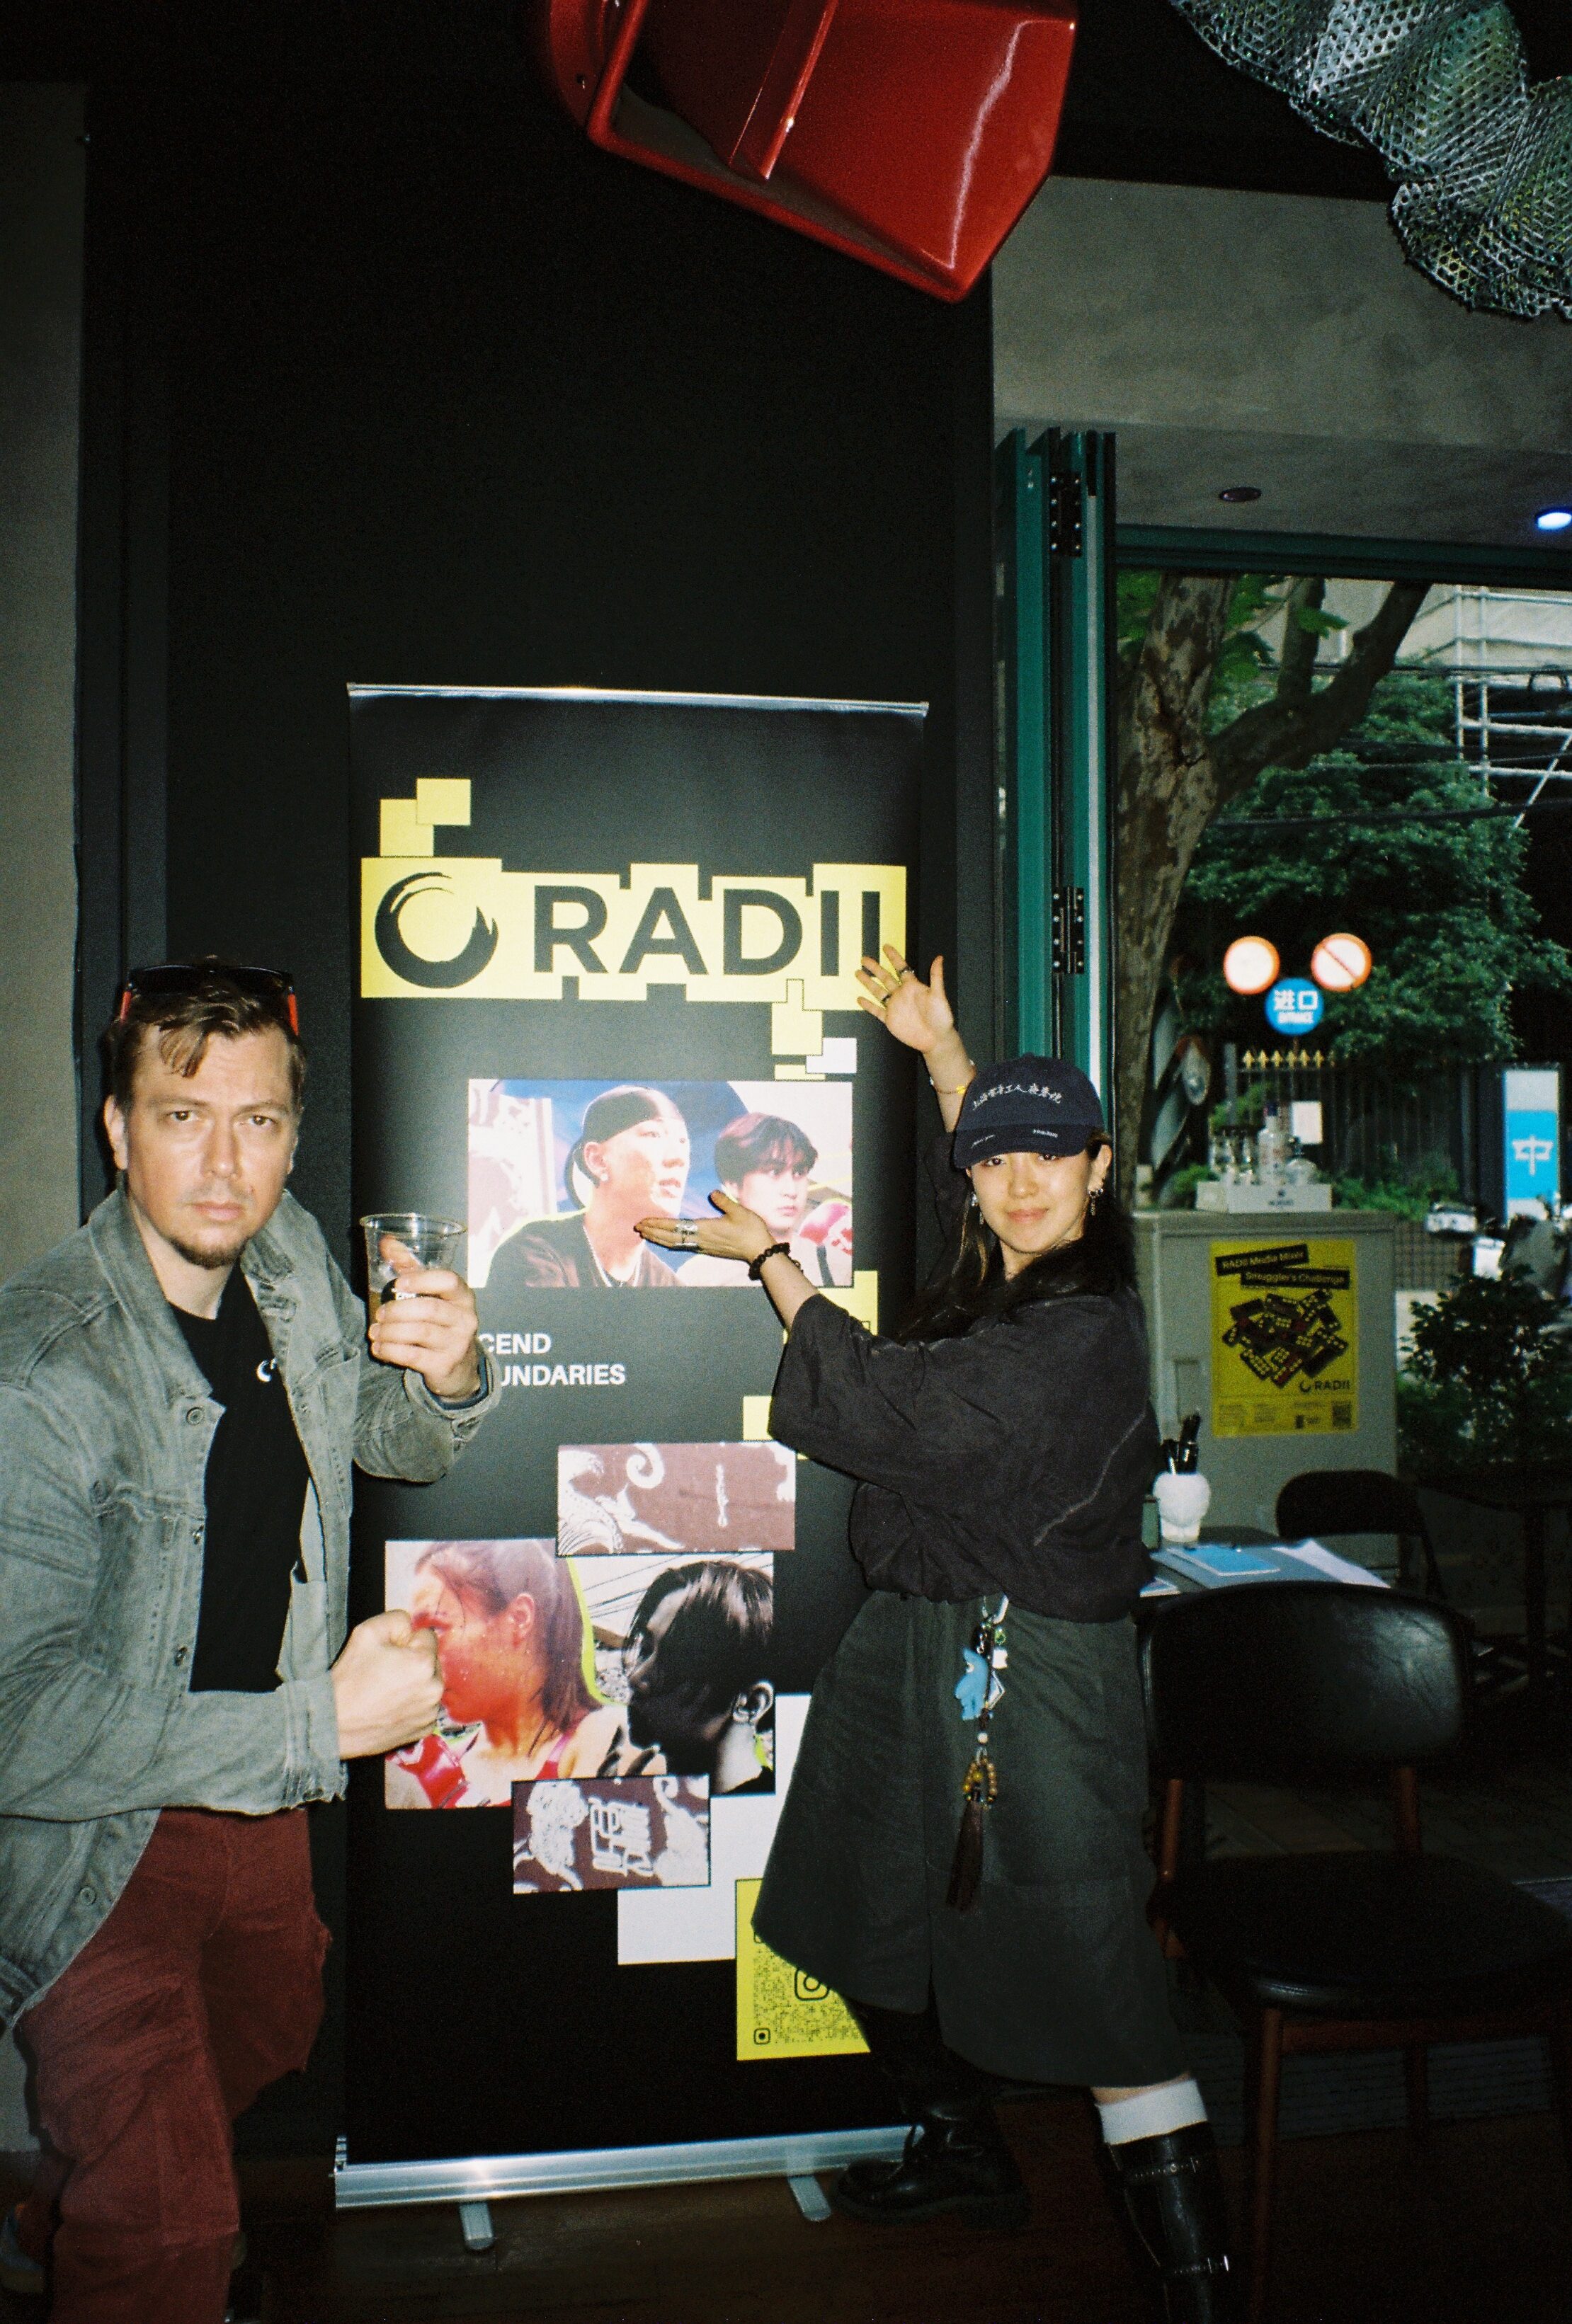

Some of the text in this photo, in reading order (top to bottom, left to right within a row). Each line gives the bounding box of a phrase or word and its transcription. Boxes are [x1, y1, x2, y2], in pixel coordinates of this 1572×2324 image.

[534, 885, 880, 976] RADII
[478, 1333, 552, 1354] CEND
[501, 1363, 625, 1386] UNDARIES
